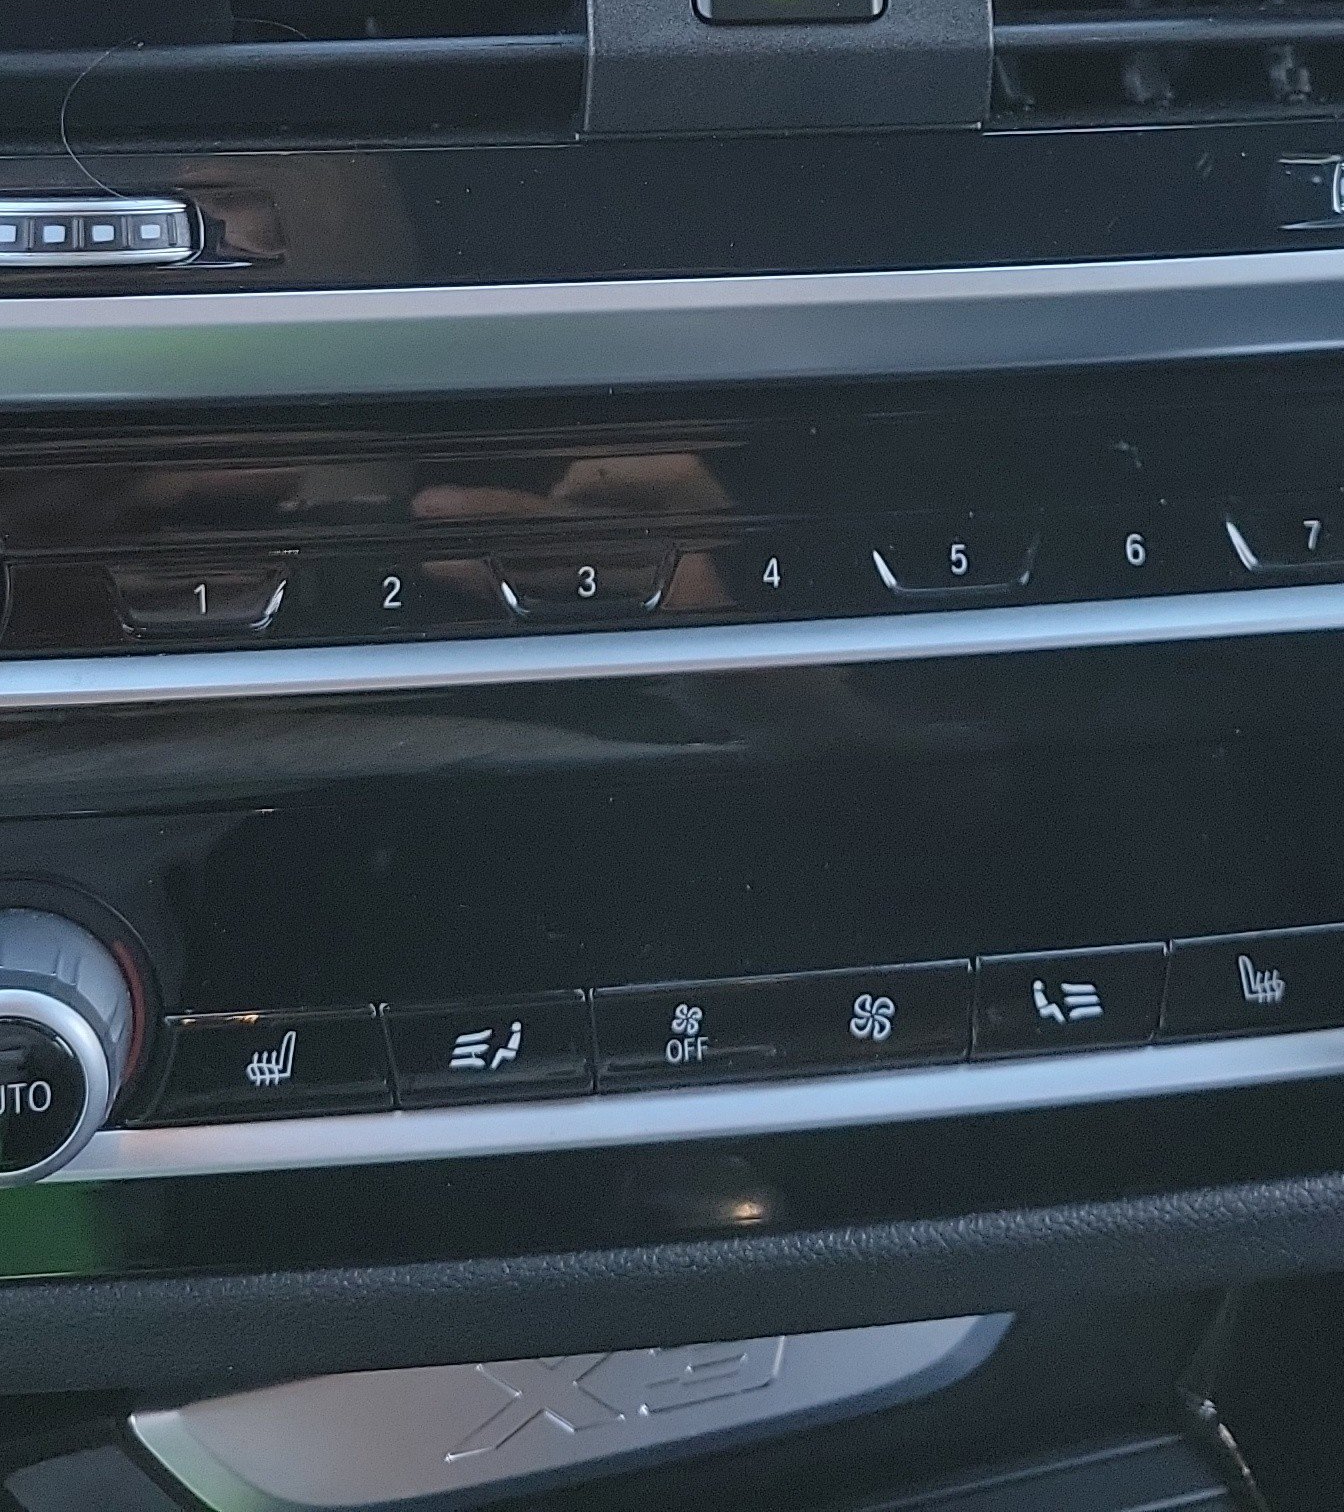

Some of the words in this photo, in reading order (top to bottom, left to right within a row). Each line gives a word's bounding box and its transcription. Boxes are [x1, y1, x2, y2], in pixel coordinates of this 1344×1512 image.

[1125, 534, 1146, 567] 6
[1304, 521, 1320, 549] 7
[762, 557, 781, 588] 4
[949, 543, 969, 575] 5
[382, 577, 402, 609] 2
[577, 566, 596, 598] 3
[193, 584, 207, 614] 1
[665, 1036, 708, 1064] OFF
